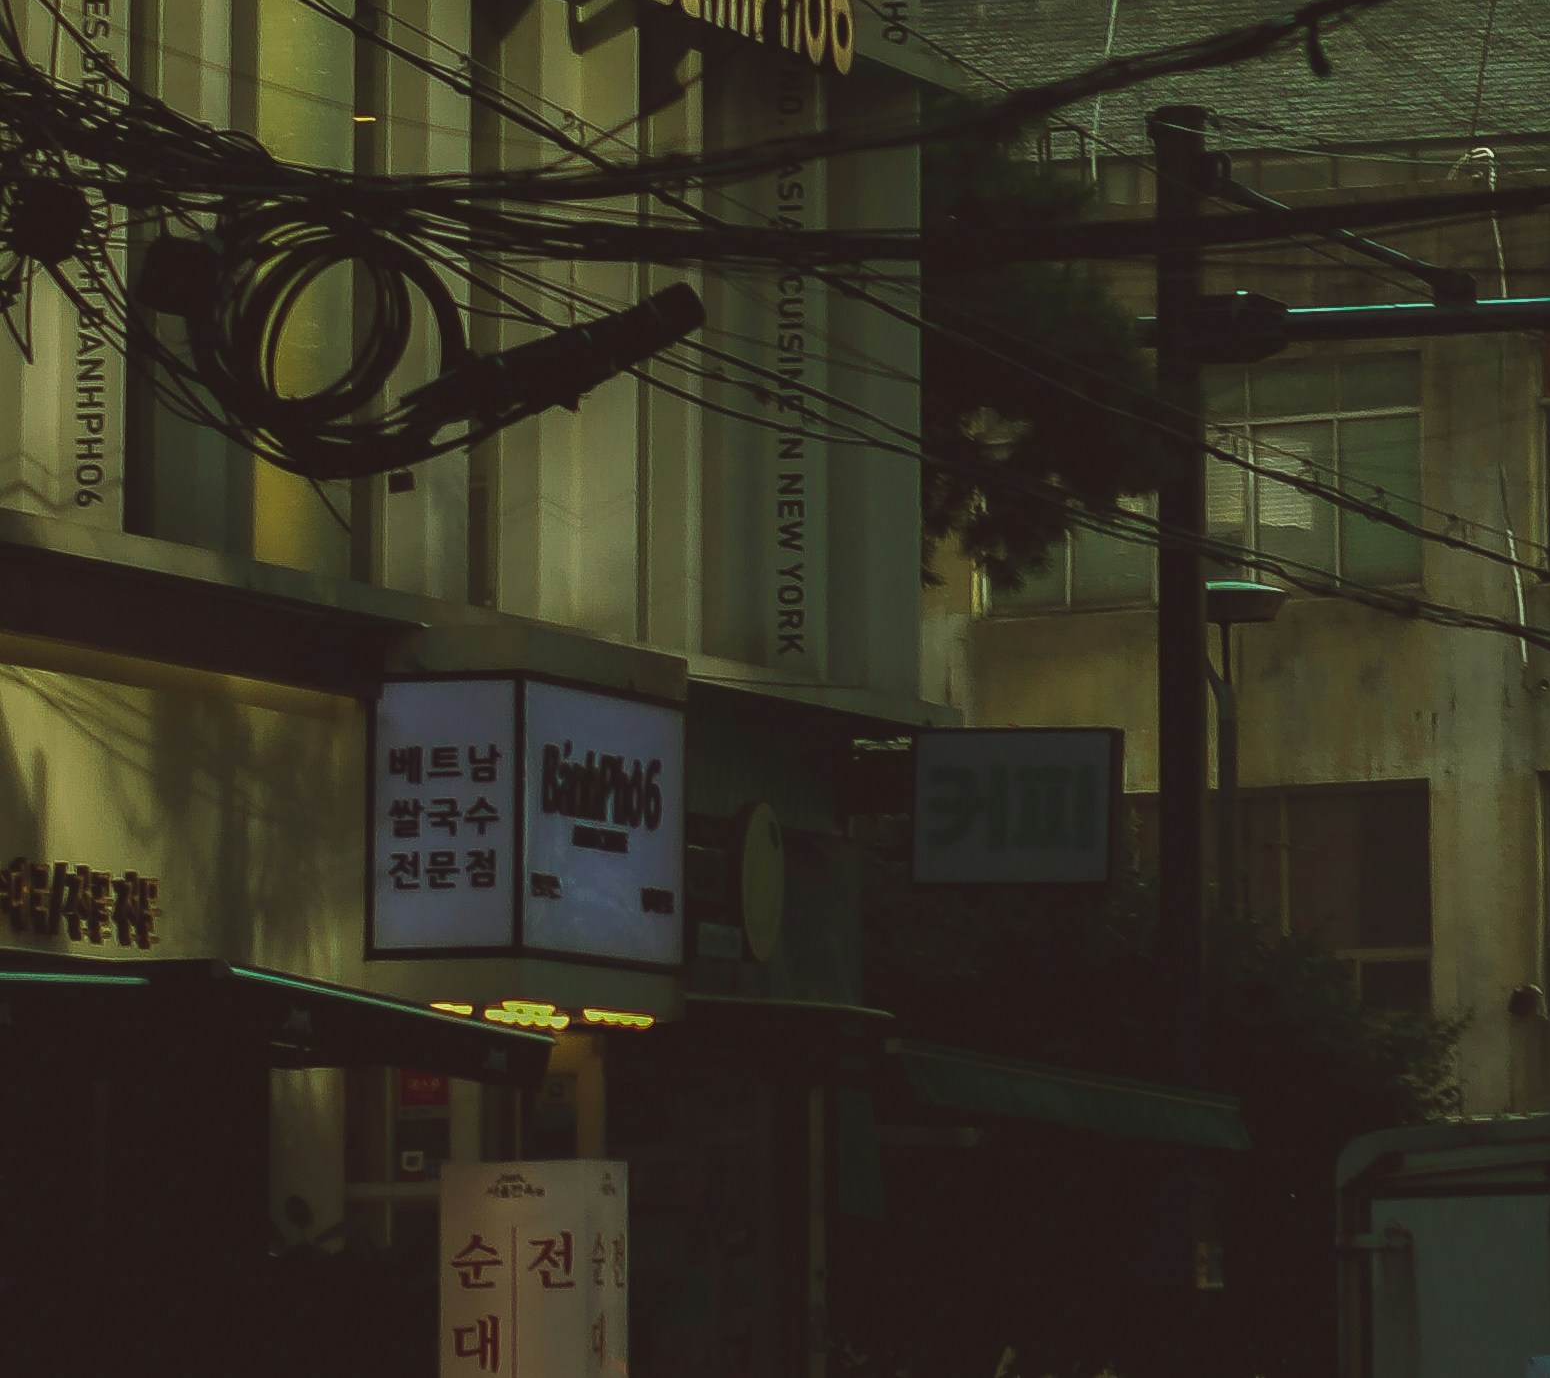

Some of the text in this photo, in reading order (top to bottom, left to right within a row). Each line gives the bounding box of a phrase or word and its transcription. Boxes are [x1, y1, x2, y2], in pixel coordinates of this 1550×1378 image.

[777, 158, 804, 235] ASIA
[777, 274, 804, 413] CUISINE
[778, 473, 805, 552] NEW
[778, 562, 805, 656] YORK
[388, 745, 502, 785] 베트남
[388, 796, 501, 839] 쌀국수
[926, 761, 1098, 853] 커피
[387, 848, 498, 892] 전문점
[527, 1228, 576, 1290] 전
